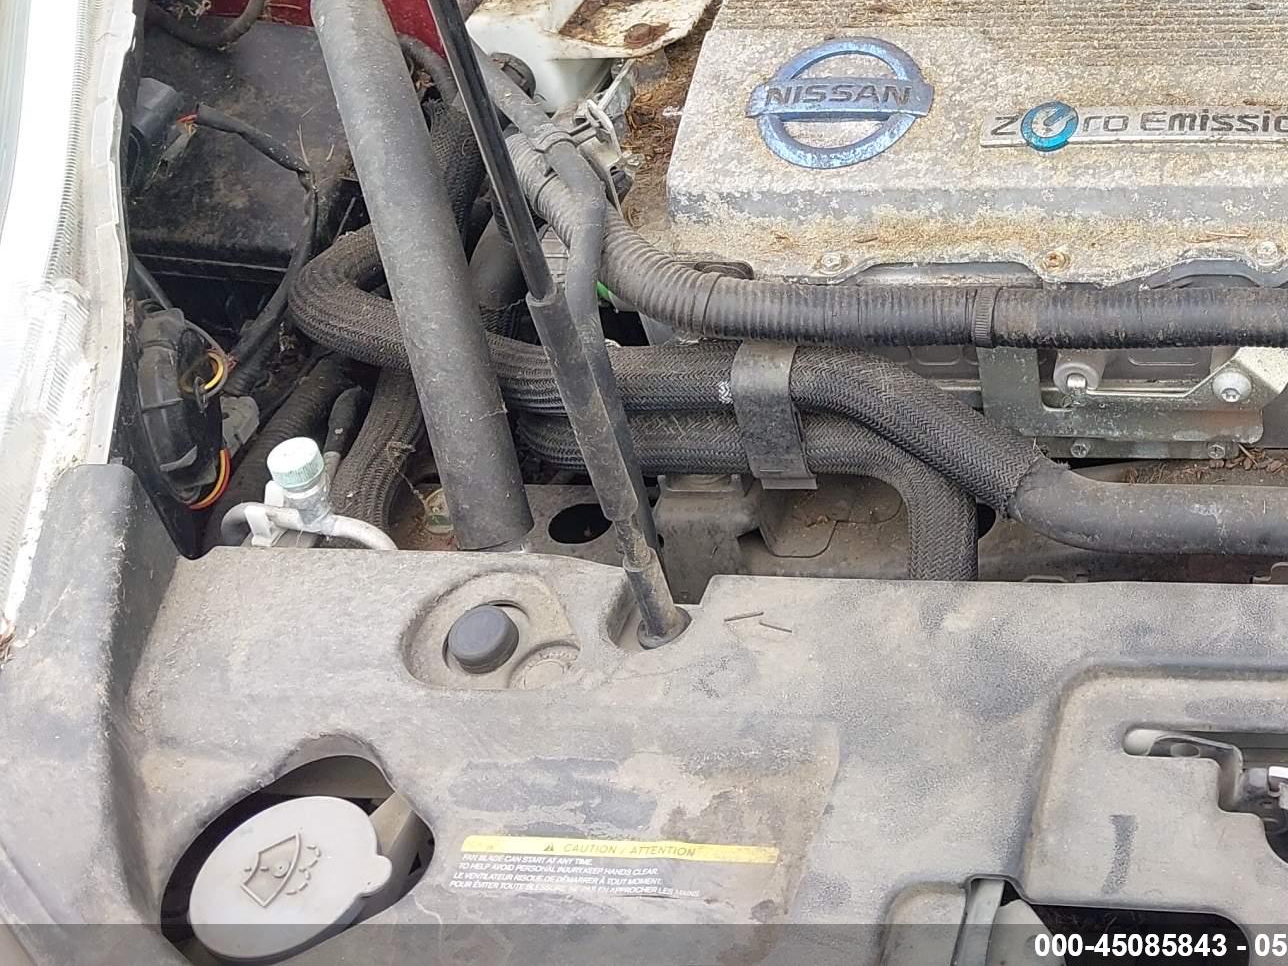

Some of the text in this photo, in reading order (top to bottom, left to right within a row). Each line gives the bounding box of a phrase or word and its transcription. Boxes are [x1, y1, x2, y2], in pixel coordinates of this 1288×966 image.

[764, 83, 911, 107] NISSAN
[563, 843, 618, 854] CAUTION
[630, 845, 697, 857] ATTENTION
[522, 856, 546, 864] START
[491, 863, 514, 872] AVOID
[515, 864, 556, 874] PERSONAL
[604, 868, 632, 876] HANDS
[464, 872, 514, 882] VENTILATEUR
